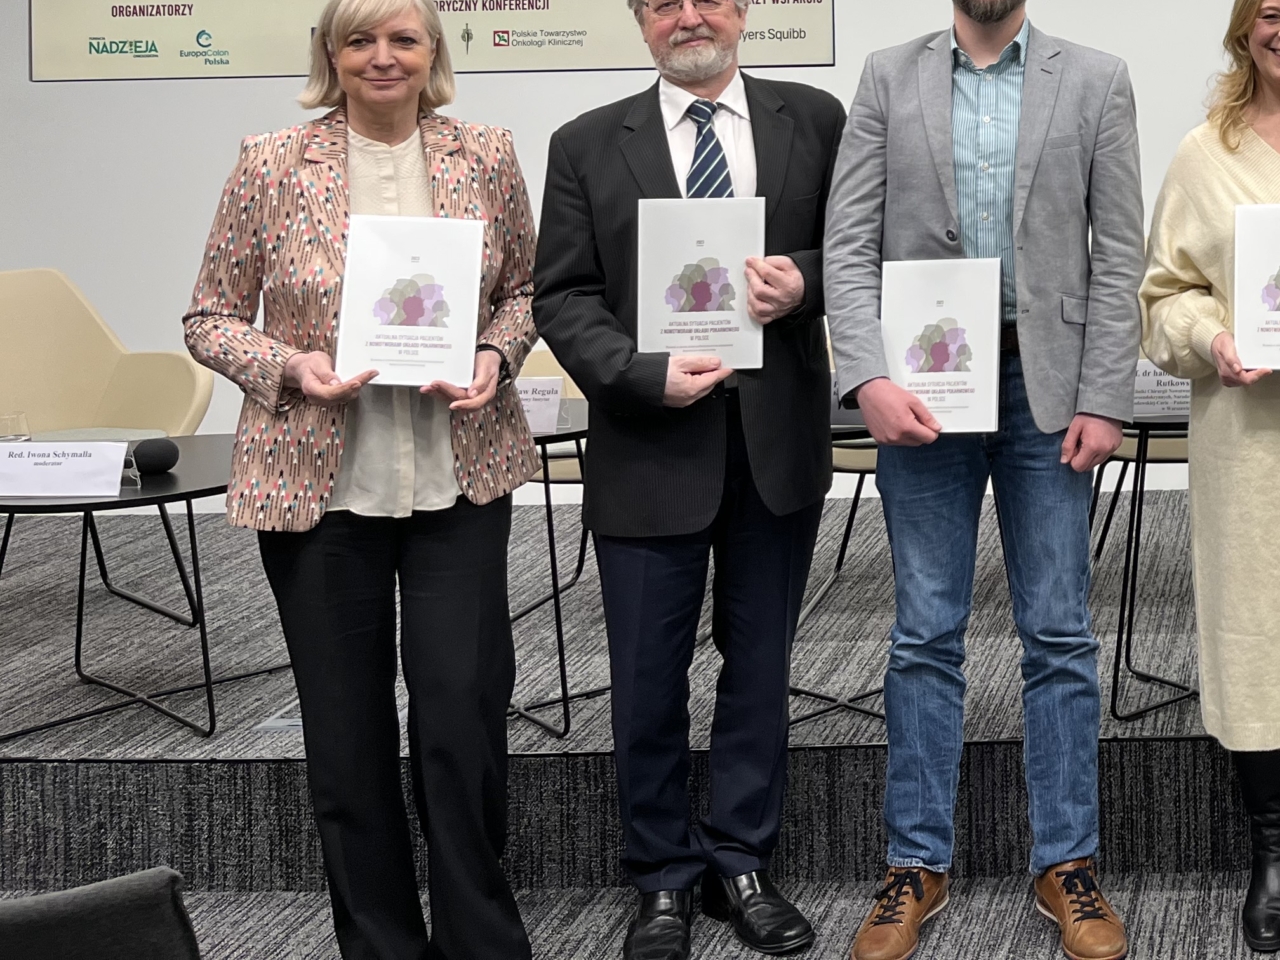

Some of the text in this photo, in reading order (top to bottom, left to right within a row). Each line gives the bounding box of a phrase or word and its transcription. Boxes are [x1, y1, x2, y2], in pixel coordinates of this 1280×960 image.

[111, 4, 194, 18] ORGANIZATORZY
[434, 0, 478, 12] RYCZNY
[540, 30, 587, 38] Towarzystwo
[740, 28, 806, 42] yers Squibb
[511, 38, 583, 47] Onkologii Klinicznej
[52, 451, 92, 460] Schymalla
